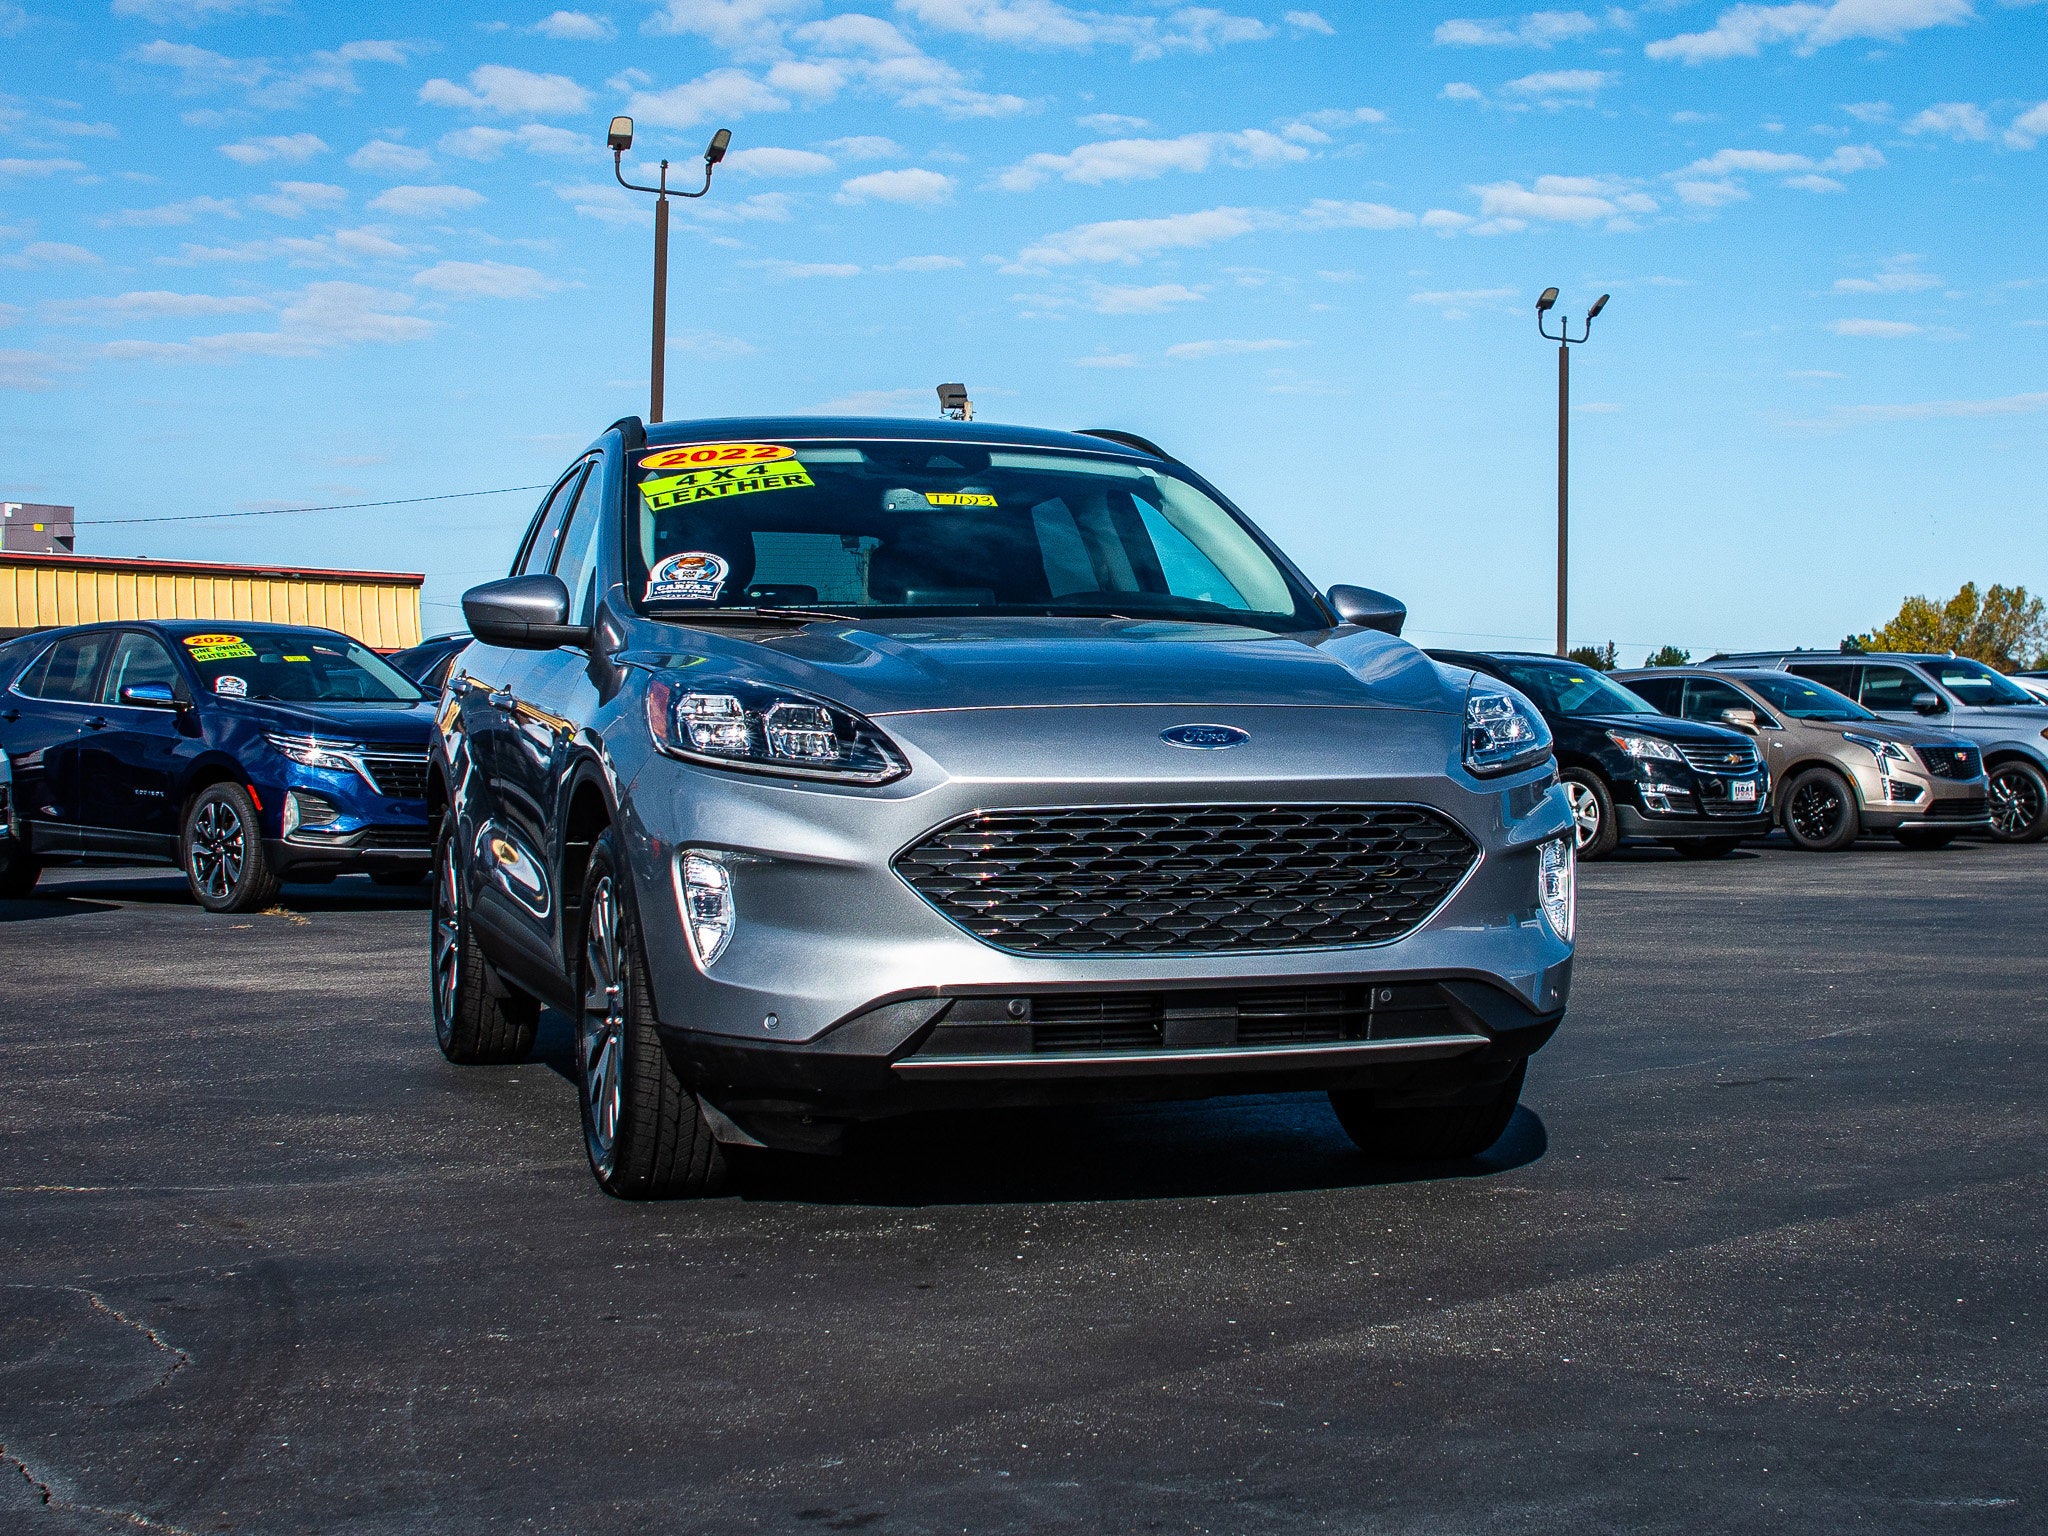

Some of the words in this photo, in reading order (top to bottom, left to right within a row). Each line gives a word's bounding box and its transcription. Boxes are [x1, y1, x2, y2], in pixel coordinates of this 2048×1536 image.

[658, 446, 780, 467] 2022
[652, 474, 809, 509] LEATHER
[193, 636, 237, 645] 2022
[193, 647, 213, 655] ONE
[215, 644, 248, 652] OWNER
[196, 652, 228, 660] HEATED
